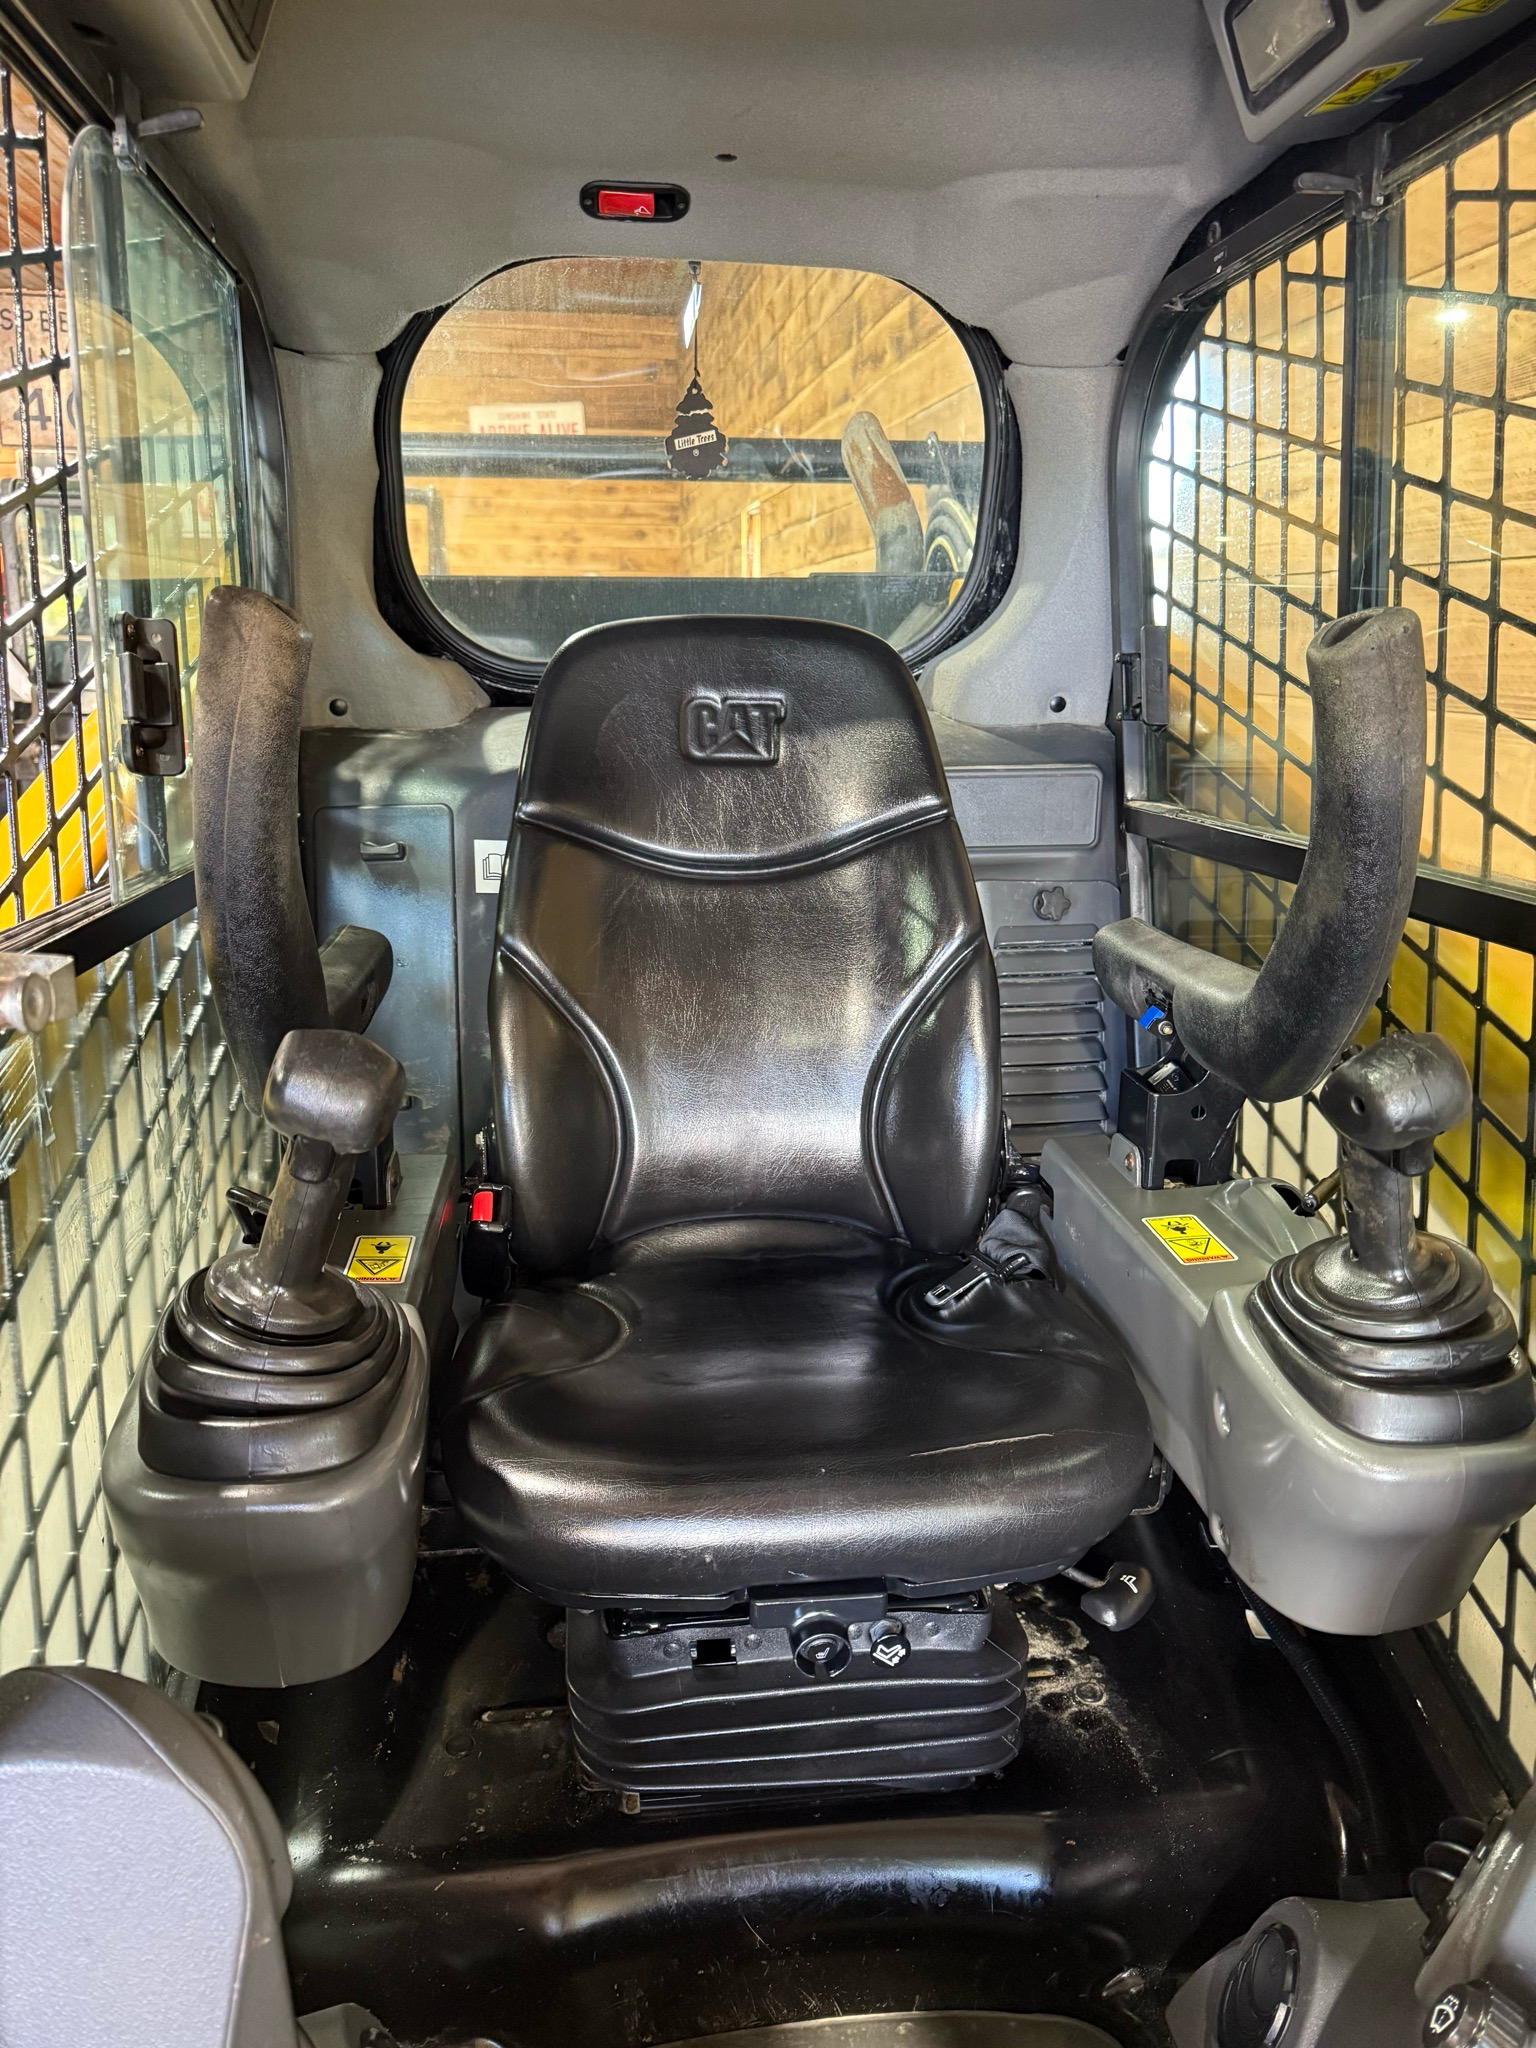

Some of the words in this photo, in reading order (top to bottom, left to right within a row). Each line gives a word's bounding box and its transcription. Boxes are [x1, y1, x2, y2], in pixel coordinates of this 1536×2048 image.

[0, 307, 69, 333] SPEE
[677, 436, 696, 449] Little
[696, 433, 715, 444] Trees
[680, 692, 788, 764] CAT
